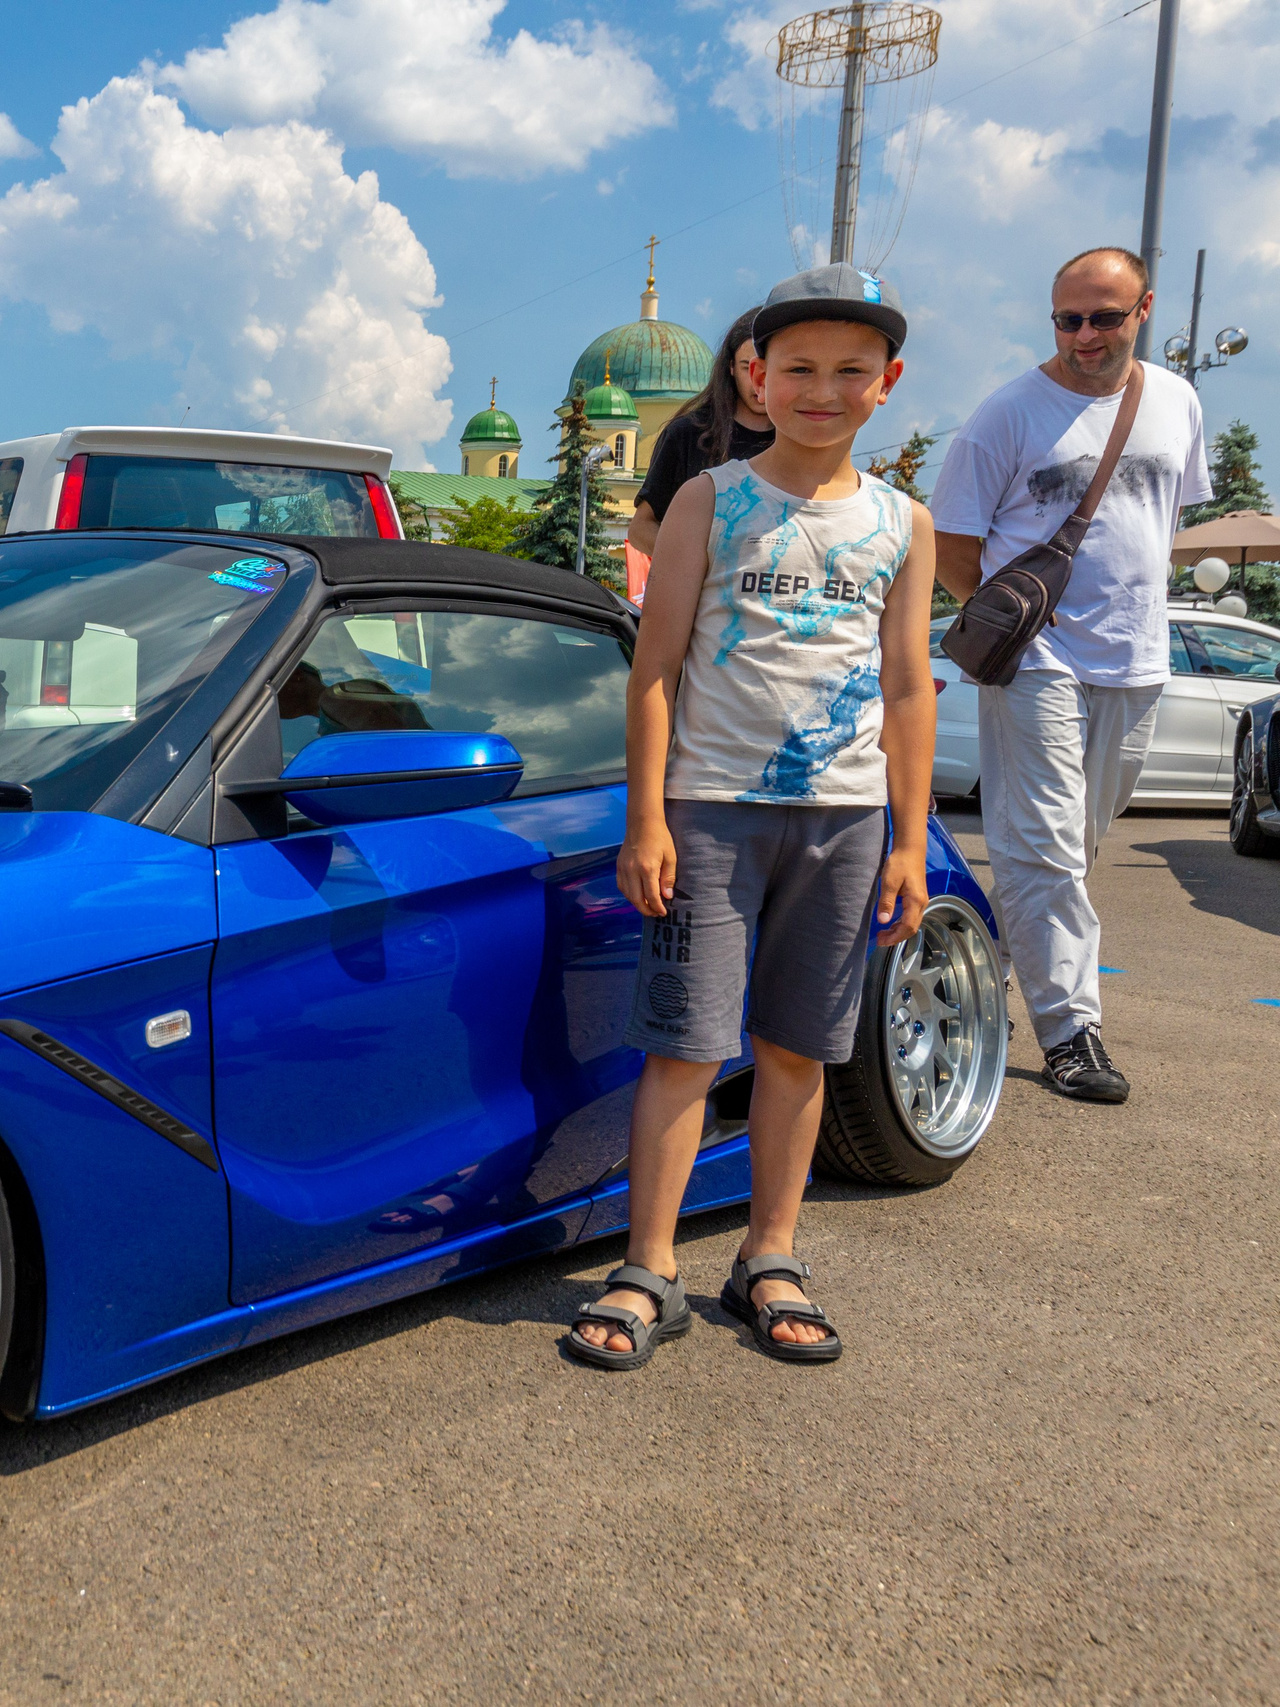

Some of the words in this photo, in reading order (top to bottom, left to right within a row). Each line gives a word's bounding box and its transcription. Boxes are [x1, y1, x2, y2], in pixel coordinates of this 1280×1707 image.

[741, 571, 810, 595] DEEP
[656, 908, 692, 927] ALI
[652, 942, 690, 963] NIA
[666, 1024, 691, 1036] SURF
